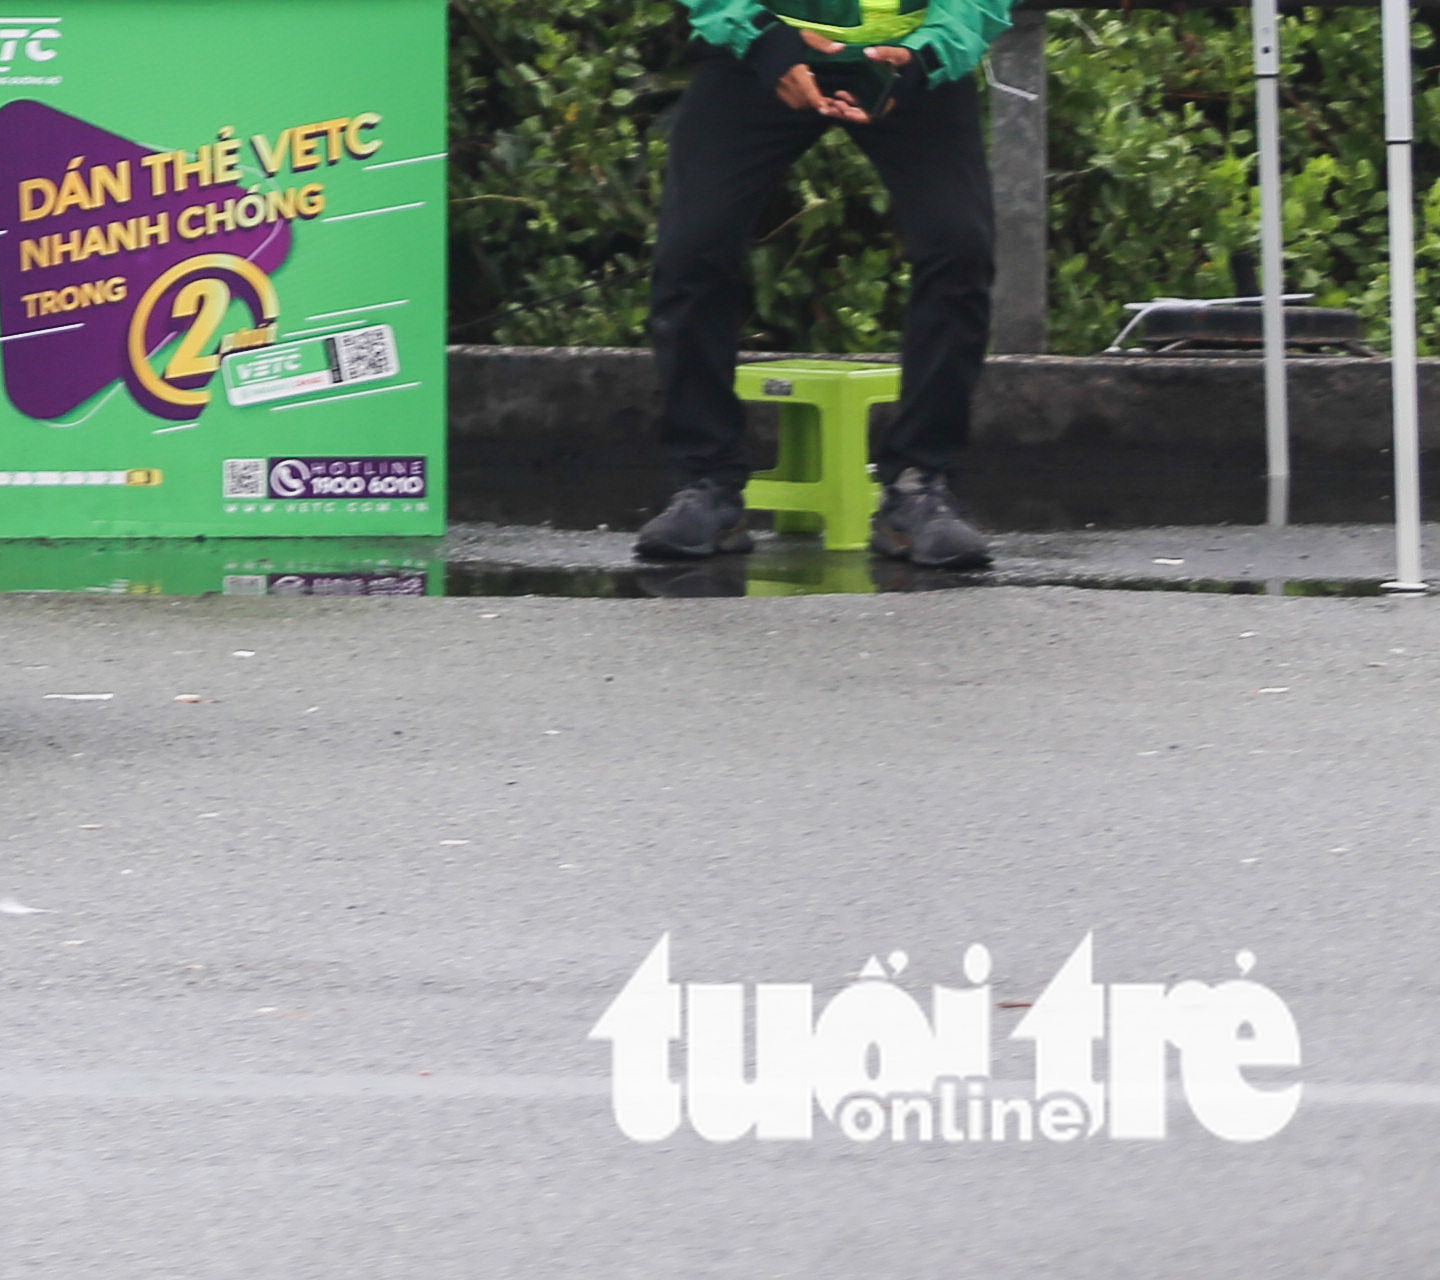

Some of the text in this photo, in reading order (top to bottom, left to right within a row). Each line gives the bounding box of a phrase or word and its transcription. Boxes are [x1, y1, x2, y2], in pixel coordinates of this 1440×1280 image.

[18, 112, 384, 223] DÁN THẺ VETC
[19, 182, 327, 273] NHANH CHÓNG
[20, 276, 231, 380] TRONG 2
[310, 460, 424, 475] HOTLINE
[310, 476, 424, 494] 1900 6010
